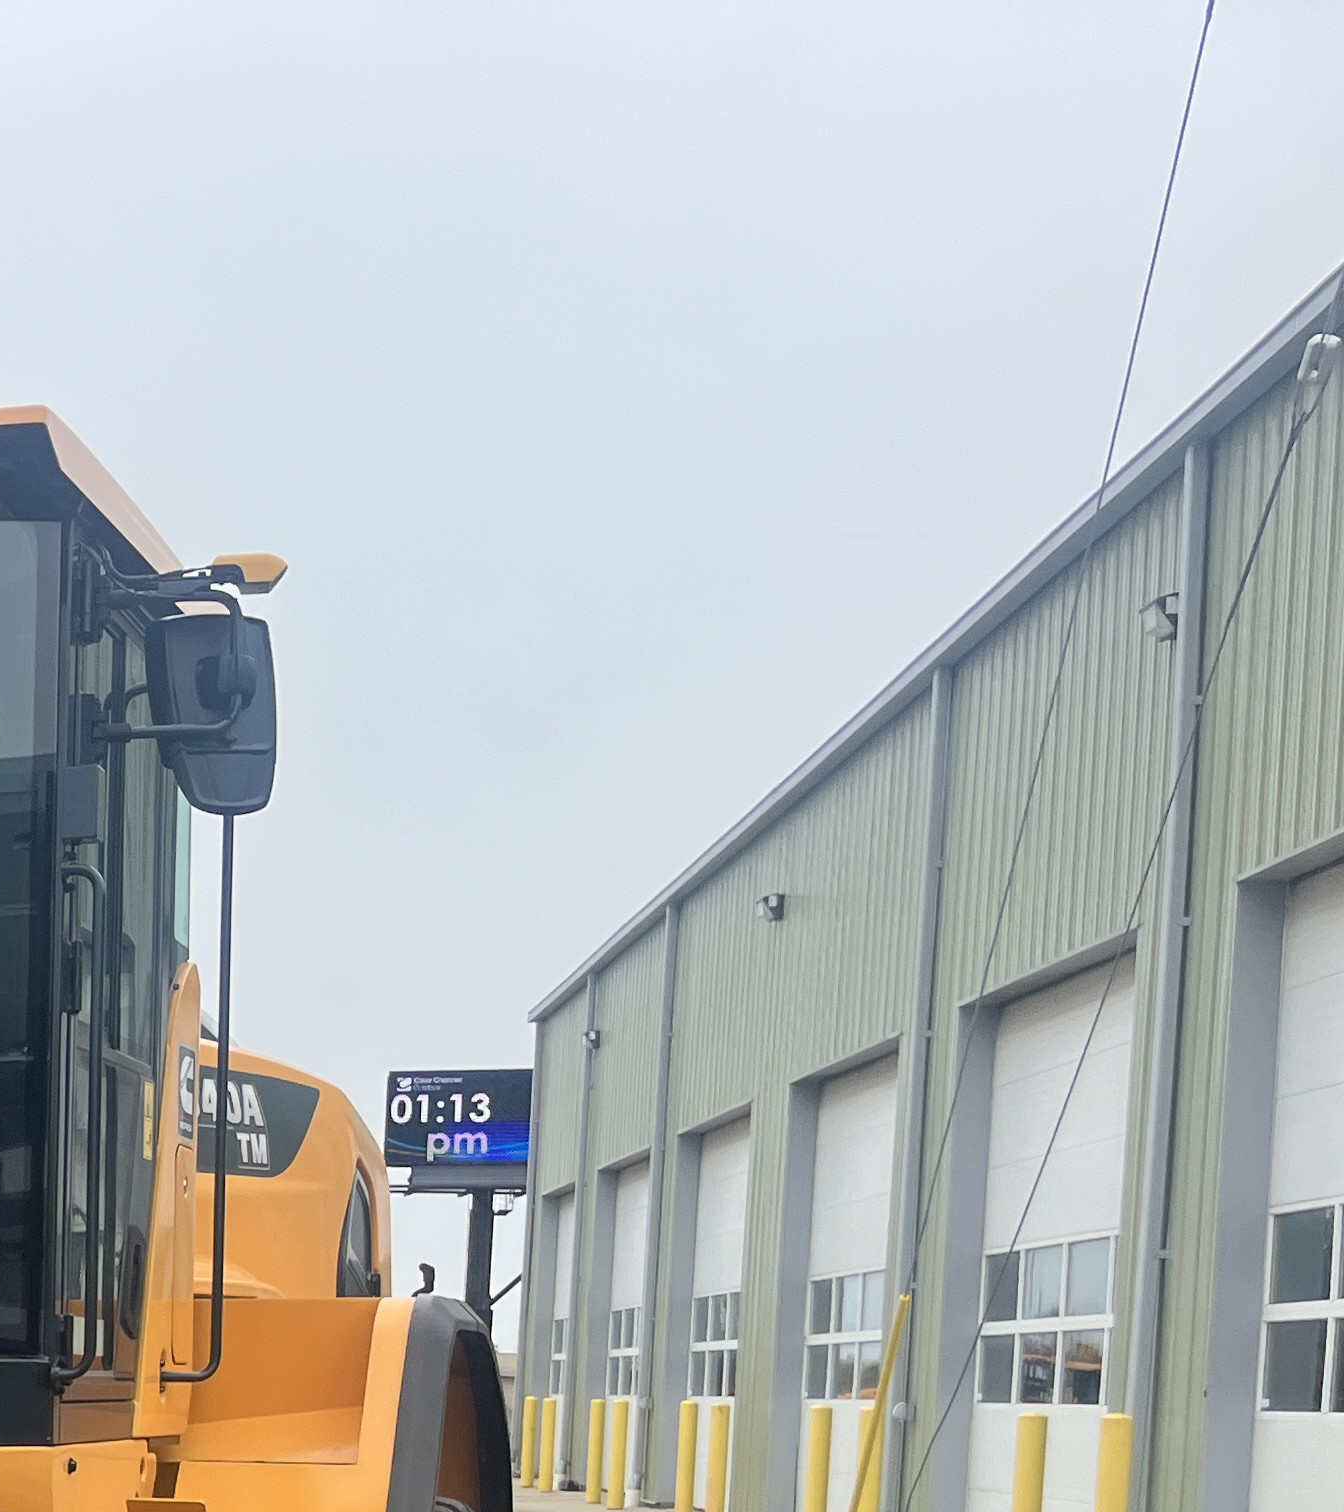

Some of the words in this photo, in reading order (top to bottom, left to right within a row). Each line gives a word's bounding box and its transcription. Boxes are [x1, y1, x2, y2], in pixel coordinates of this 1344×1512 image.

[390, 1092, 491, 1124] 01:13
[236, 1132, 268, 1165] TM
[426, 1131, 488, 1162] pm
